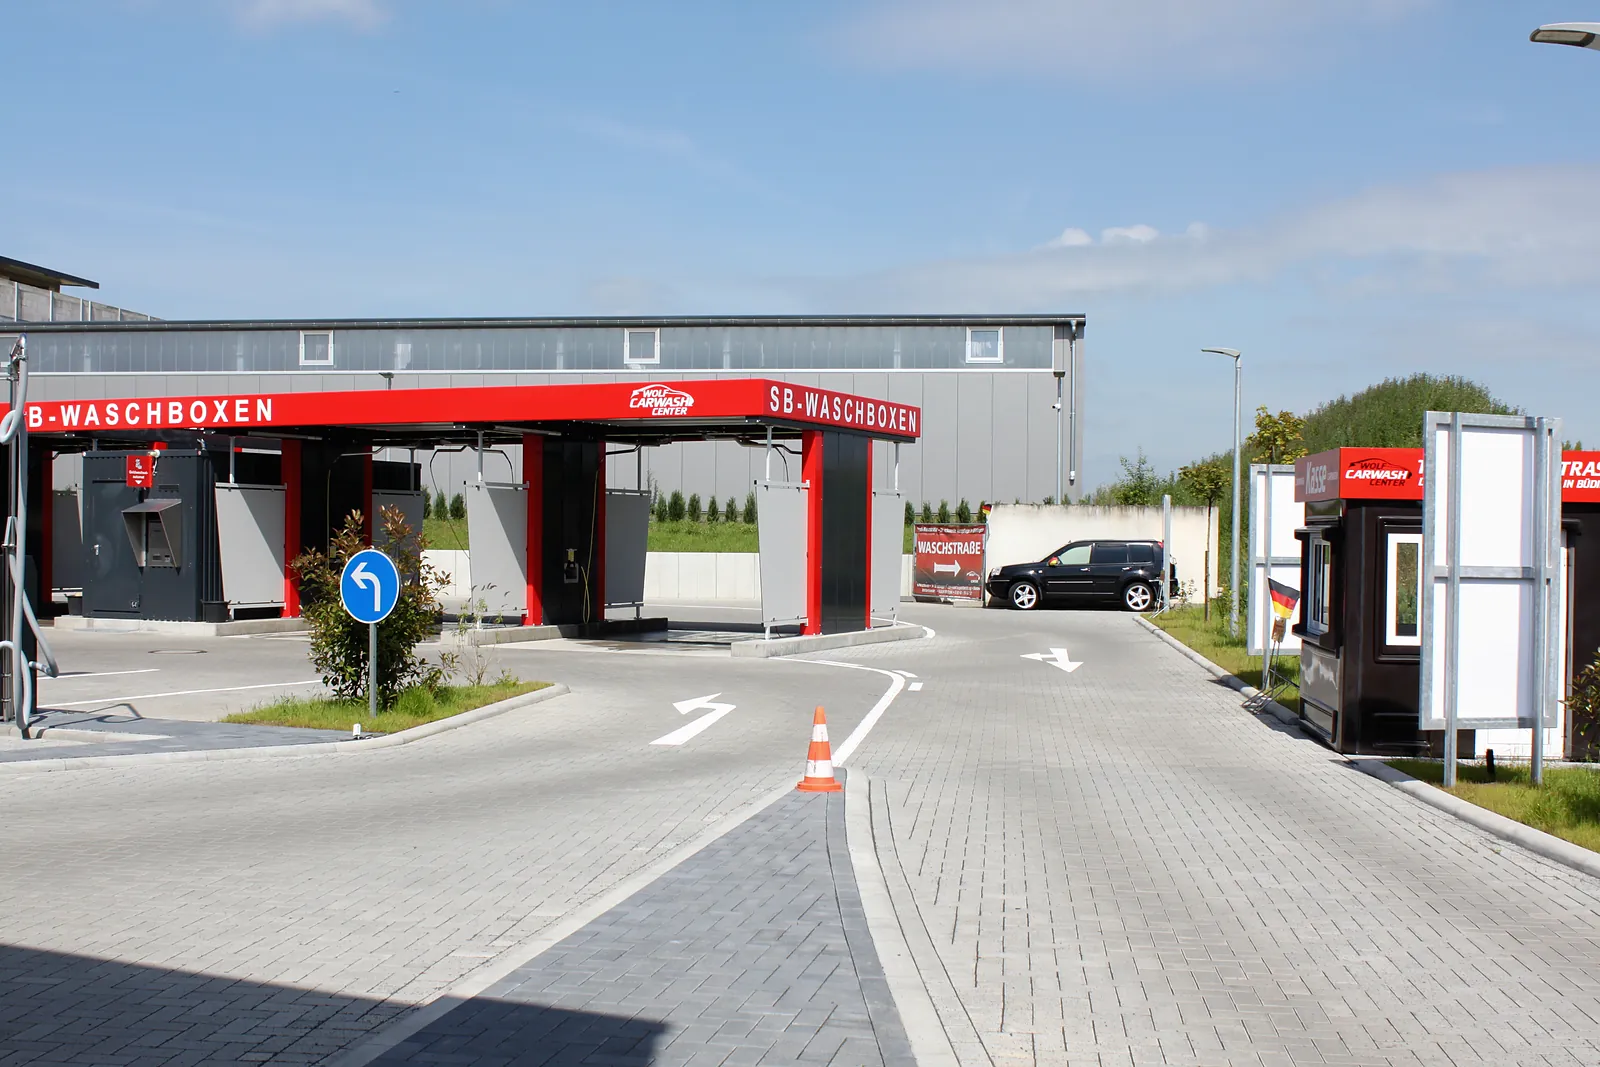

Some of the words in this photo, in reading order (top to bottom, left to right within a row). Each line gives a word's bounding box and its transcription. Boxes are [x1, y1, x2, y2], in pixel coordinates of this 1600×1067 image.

[643, 389, 669, 398] WOLF
[629, 397, 689, 408] CARWASH
[22, 398, 272, 428] B-WASCHBOXEN
[651, 407, 688, 416] CENTER
[770, 385, 916, 432] SB-WASCHBOXEN
[1360, 462, 1387, 470] WOLF
[1306, 461, 1327, 494] Kasse
[1345, 469, 1408, 480] CARWASH
[1369, 479, 1406, 487] CENTER
[1563, 479, 1575, 488] IN
